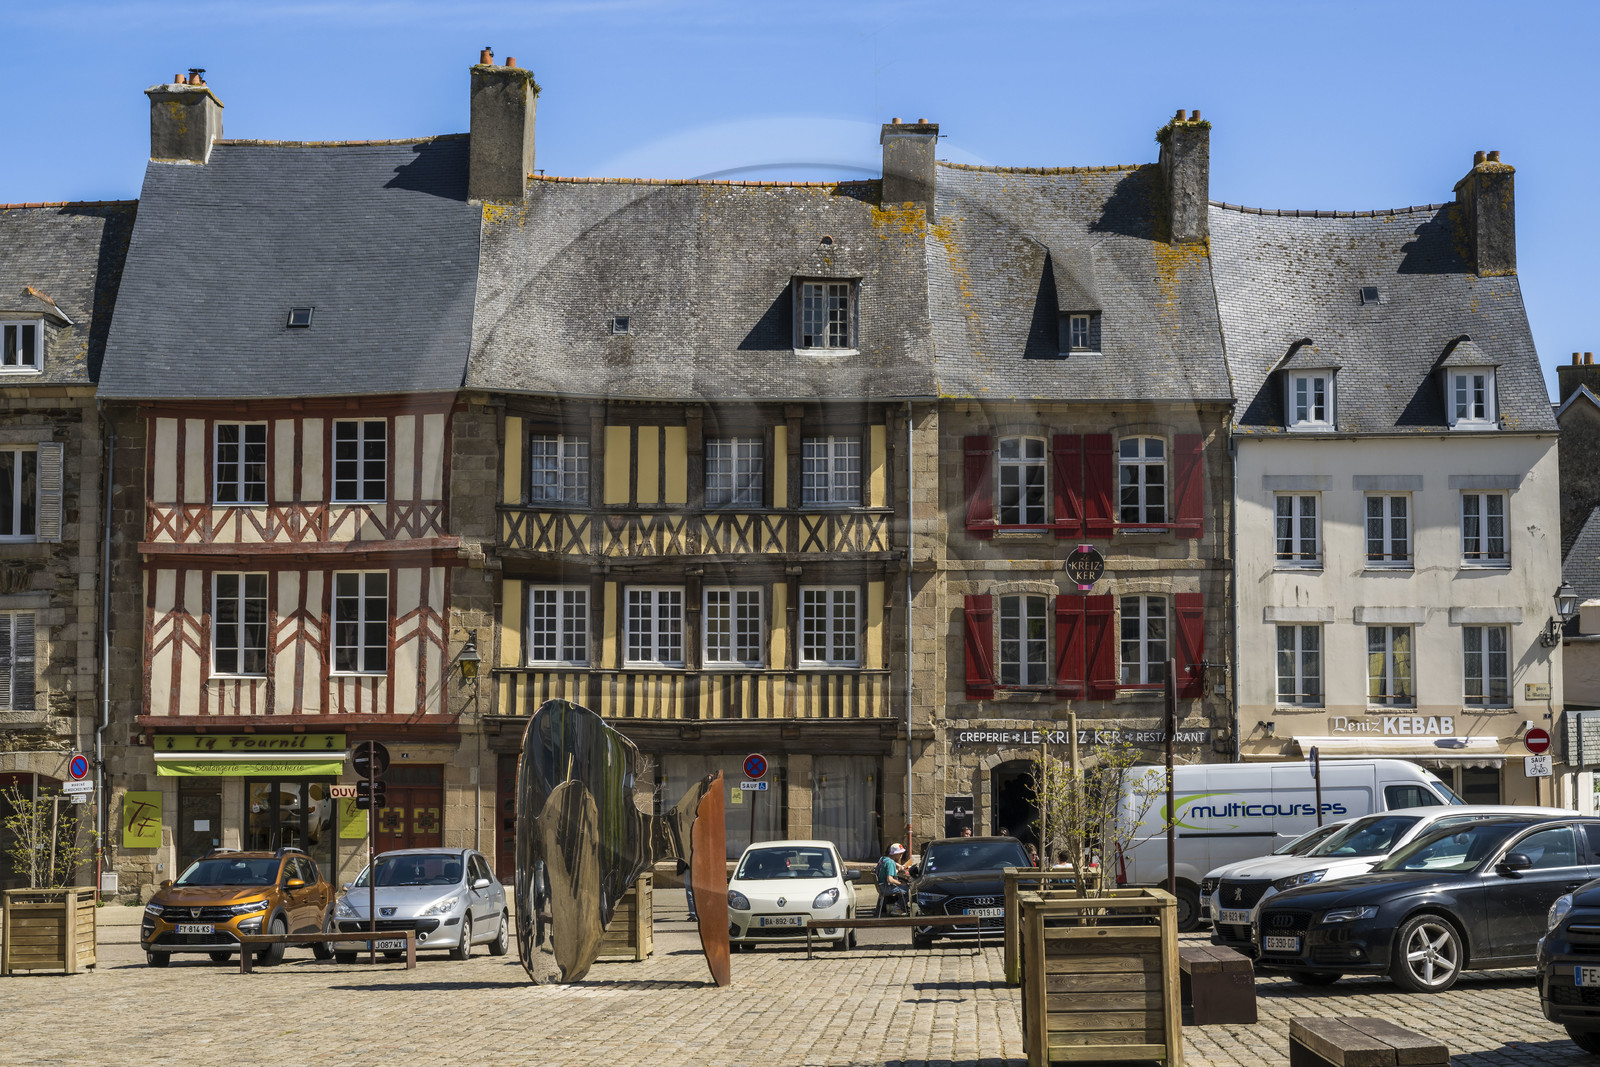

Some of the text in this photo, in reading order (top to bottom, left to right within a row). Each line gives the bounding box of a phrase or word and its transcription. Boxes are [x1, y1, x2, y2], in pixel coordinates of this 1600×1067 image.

[1071, 562, 1100, 570] KREIZ
[1076, 572, 1095, 580] KER
[1332, 716, 1454, 736] Deniz KEBAB
[194, 736, 307, 750] Ty Fournil
[960, 732, 1009, 742] CREPERIE
[1023, 731, 1039, 744] LE
[1046, 731, 1087, 744] KRZ
[1136, 732, 1205, 742] RESTARANT
[195, 762, 305, 775] Boulangerie Sandwicherie
[331, 788, 356, 797] OUV
[1192, 801, 1347, 818] multicourses
